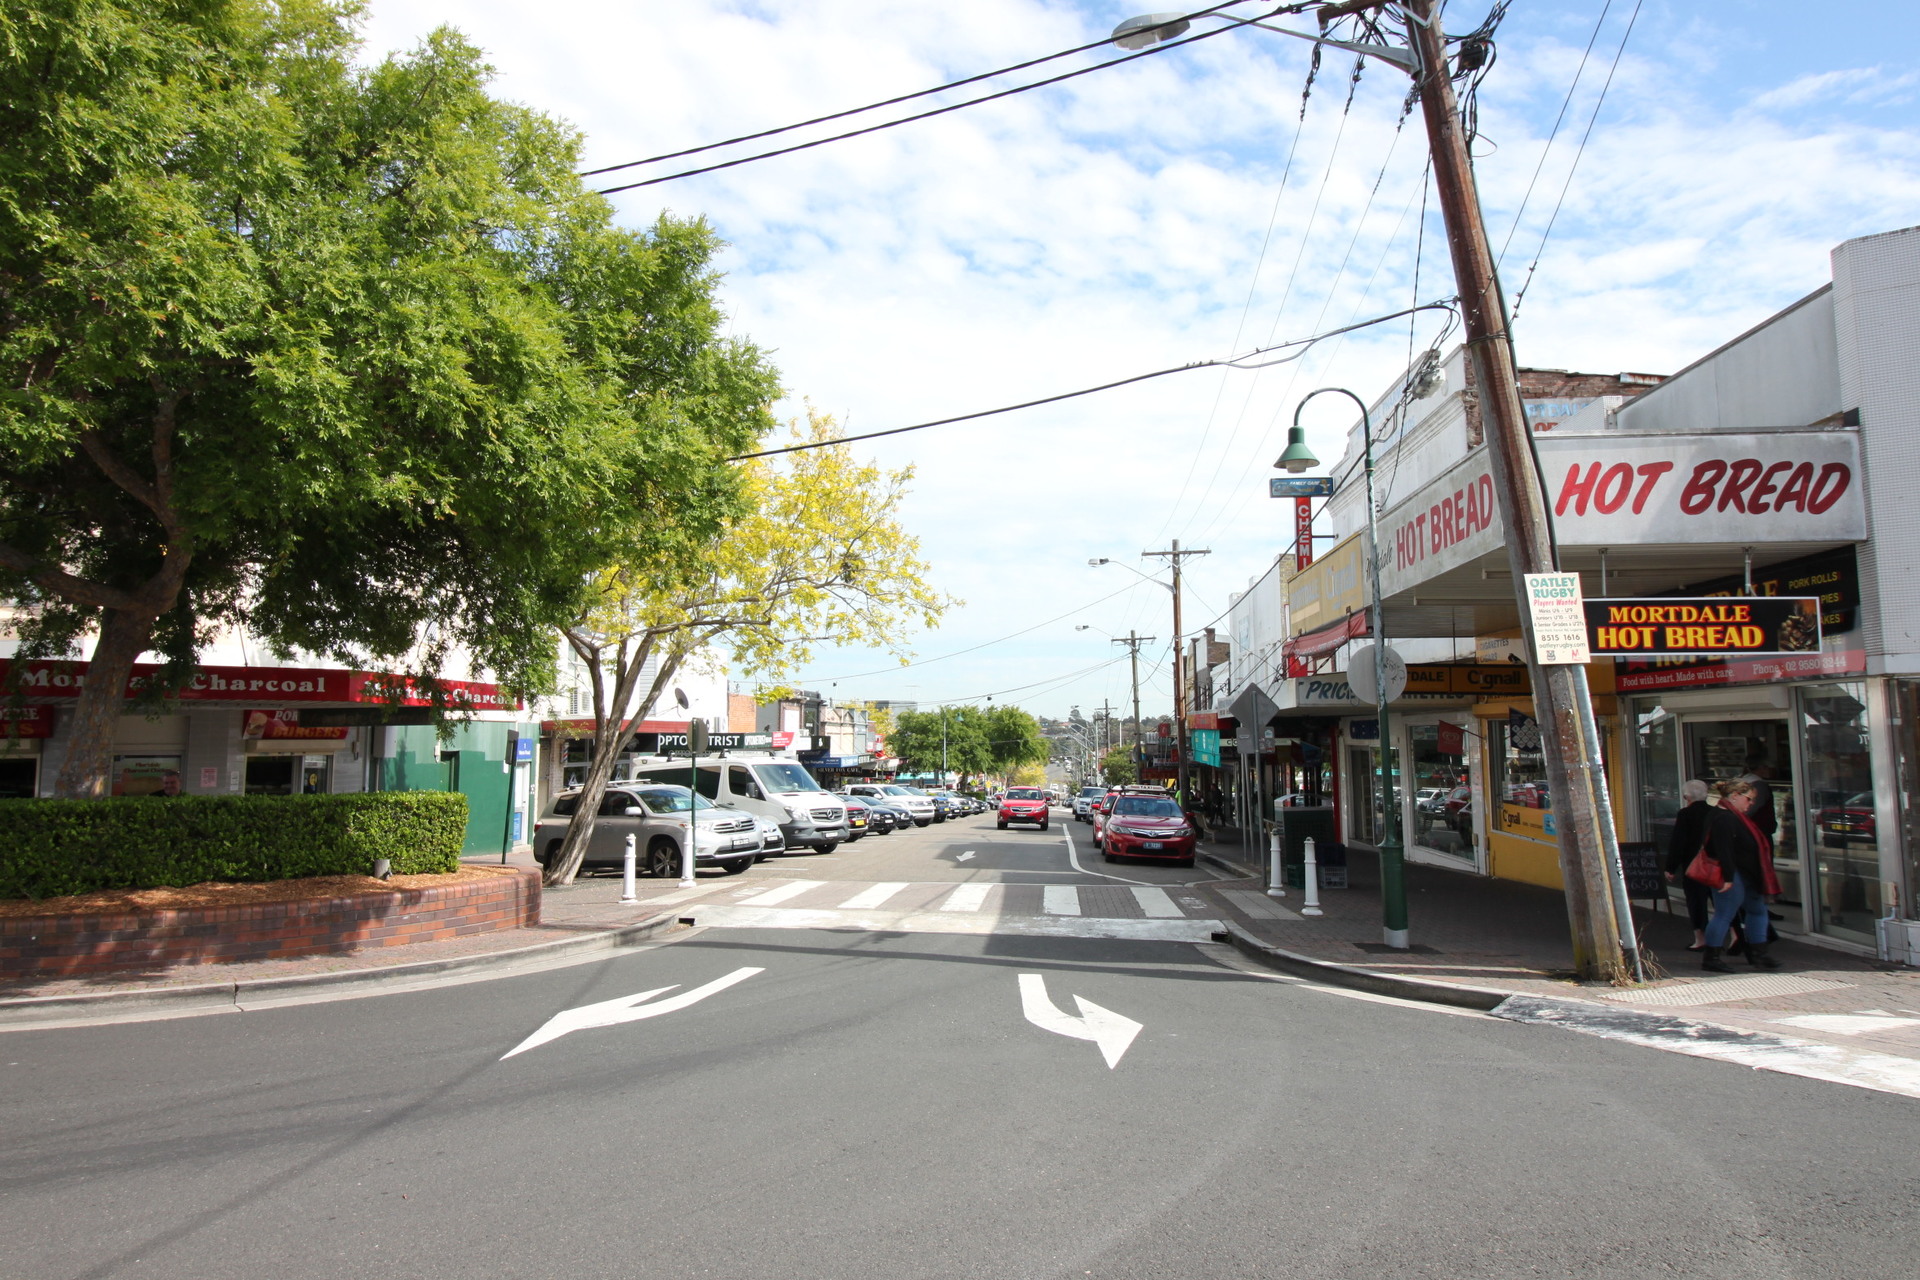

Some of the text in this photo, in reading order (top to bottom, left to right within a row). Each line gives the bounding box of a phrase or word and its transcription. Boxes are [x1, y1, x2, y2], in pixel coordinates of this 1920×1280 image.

[1554, 458, 1851, 517] HOT BREAD
[1396, 512, 1426, 572] HOT
[1430, 473, 1493, 555] BREAD
[1530, 577, 1576, 588] OATLEY
[1788, 579, 1810, 590] PORK
[1811, 571, 1838, 584] ROLLS
[1533, 588, 1575, 598] RUGBY
[1820, 592, 1839, 604] PIES
[1533, 598, 1578, 608] Players Wanted
[1608, 605, 1751, 624] MORTDALE
[1539, 642, 1586, 650] oatleyrugby.com
[1541, 634, 1560, 642] 8515
[1596, 625, 1765, 649] HOT BREAD
[1752, 663, 1779, 675] Phone
[1785, 661, 1797, 672] 02
[1798, 659, 1820, 670] 9580
[1822, 656, 1847, 668] 3244
[190, 673, 326, 693] Charcoal
[1467, 670, 1522, 690] Cignall
[1622, 668, 1735, 687] Food with heart. Made with care.
[271, 726, 342, 738] BURGERS
